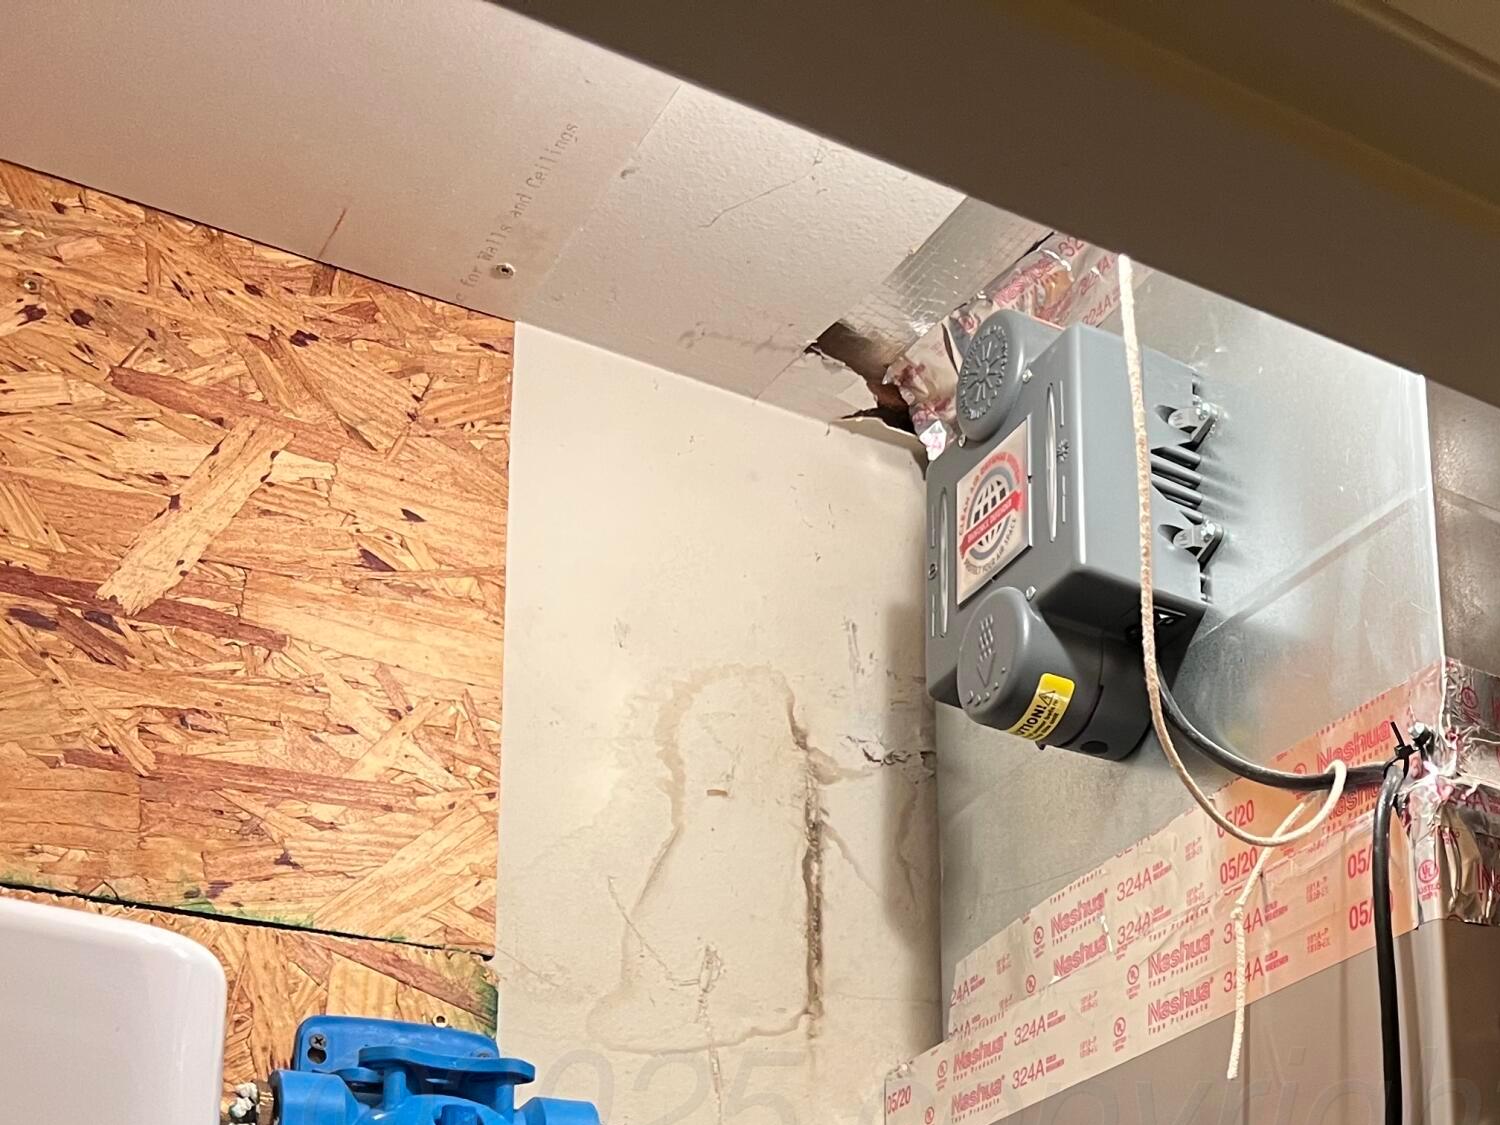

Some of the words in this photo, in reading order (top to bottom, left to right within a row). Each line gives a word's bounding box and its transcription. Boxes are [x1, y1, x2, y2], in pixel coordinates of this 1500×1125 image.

[477, 224, 512, 261] Walls
[510, 193, 532, 218] and
[526, 123, 578, 189] Ceilings
[1316, 719, 1392, 773] Nashua
[1347, 844, 1373, 879] 05/
[1051, 890, 1106, 938] Nashua
[1117, 868, 1152, 901] 324A
[1220, 847, 1257, 885] 05/20
[1349, 897, 1374, 931] 05/
[1054, 932, 1107, 977] Nashua
[1117, 912, 1151, 945] 324A
[1148, 931, 1212, 979] Nashua
[1148, 978, 1212, 1027] Nashua
[953, 1036, 1004, 1075] Nashua
[1014, 1015, 1047, 1047] 324A
[886, 1085, 911, 1114] 05/20
[952, 1077, 1003, 1116] Nashua
[1012, 1059, 1045, 1090] 324A
